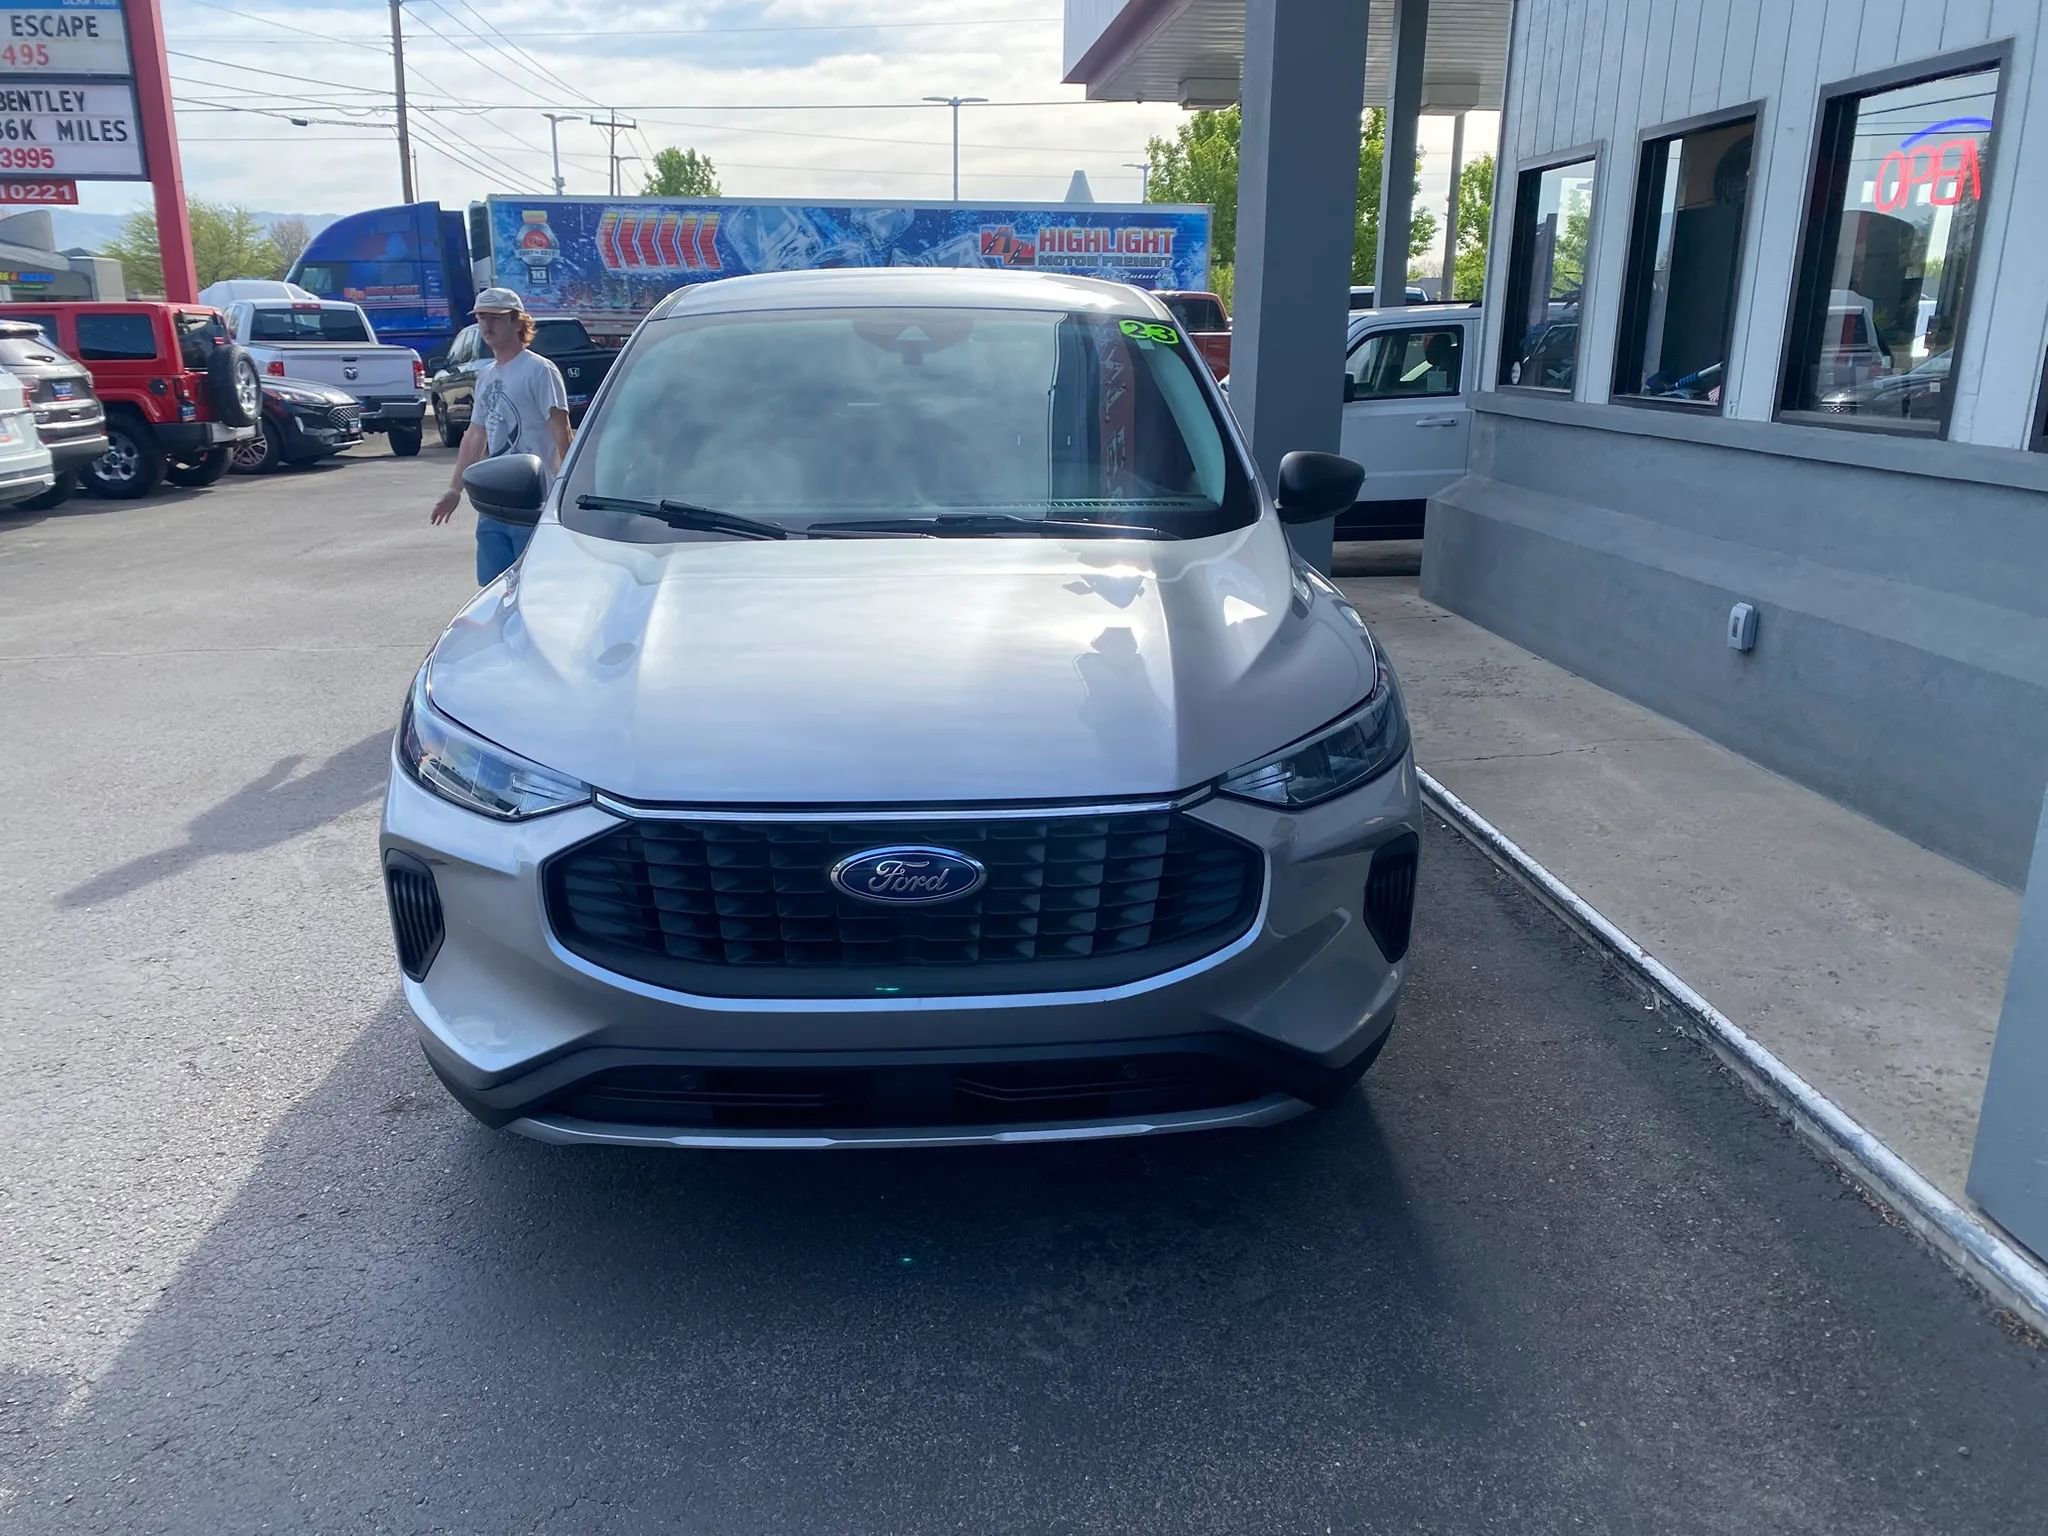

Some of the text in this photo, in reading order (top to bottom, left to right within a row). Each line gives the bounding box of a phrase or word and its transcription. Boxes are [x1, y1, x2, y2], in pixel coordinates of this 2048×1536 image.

[10, 14, 99, 38] ESCAPE
[1, 43, 49, 66] 495
[56, 119, 128, 142] MILES
[0, 147, 55, 169] 3995
[1038, 226, 1176, 254] HIGHLIGHT
[1038, 254, 1174, 268] MOTOR FREIGHT
[1124, 322, 1174, 342] 23
[868, 860, 950, 892] Ford
